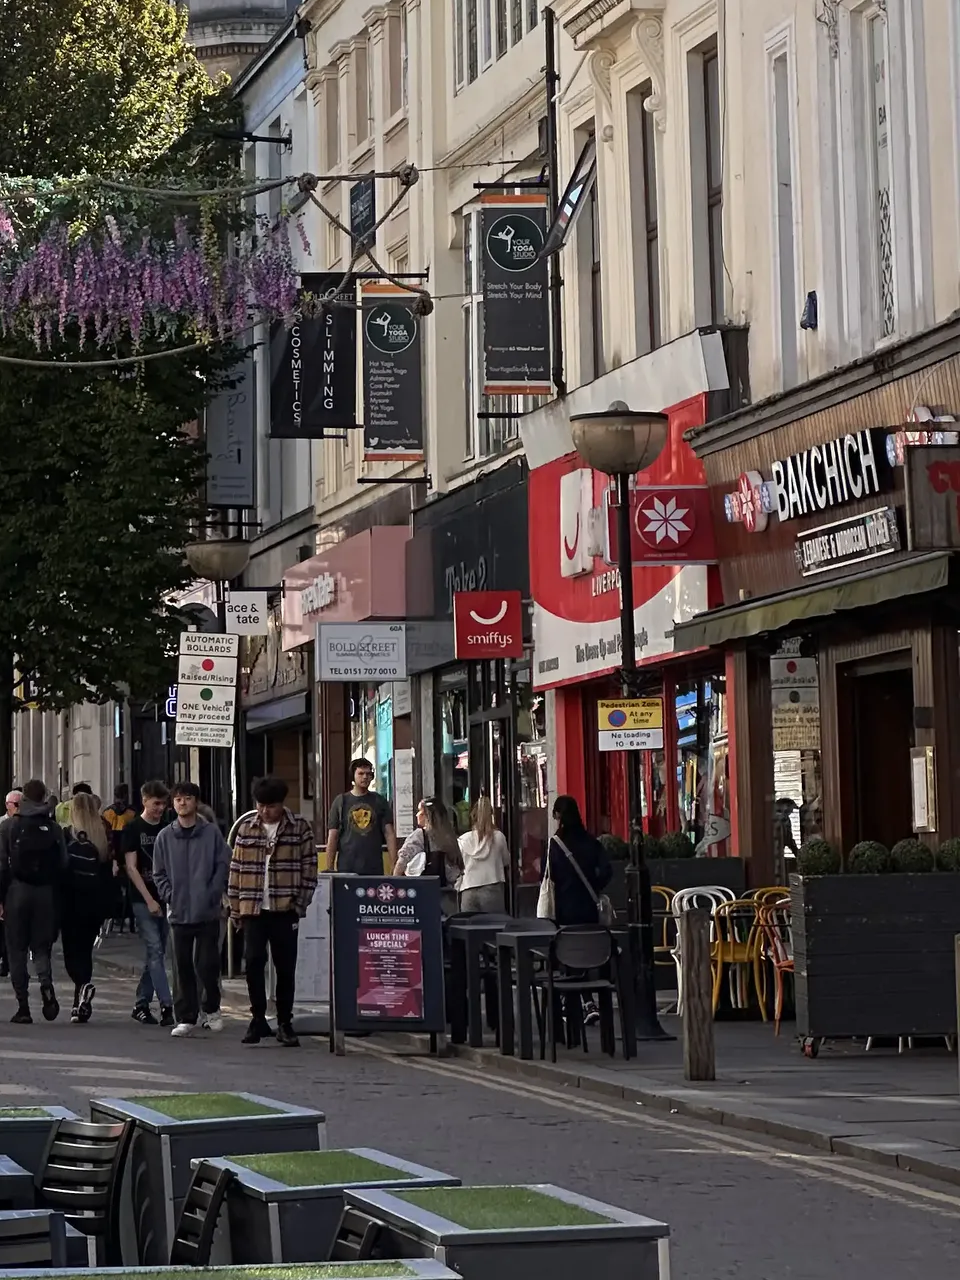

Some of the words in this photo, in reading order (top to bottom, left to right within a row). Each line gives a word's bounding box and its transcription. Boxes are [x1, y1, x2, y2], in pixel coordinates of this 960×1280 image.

[525, 283, 542, 291] Body
[525, 291, 542, 299] Mind
[323, 314, 334, 409] SLIMMING
[291, 326, 302, 422] COSMETICS
[393, 368, 407, 376] Yoga
[772, 428, 880, 522] BAKCHICH
[592, 568, 622, 597] LIVERPO
[227, 604, 248, 613] ace
[250, 603, 259, 612] &
[236, 614, 260, 624] tate
[185, 636, 234, 645] AUTOMATIC
[467, 632, 512, 648] smiffys
[187, 645, 231, 653] BOLLARDS
[329, 643, 356, 652] BOLD
[359, 642, 397, 652] STREET
[181, 673, 234, 683] Raised/Rising
[182, 703, 200, 711] ONE
[202, 704, 230, 712] Vehicle
[180, 712, 197, 720] may
[198, 713, 231, 721] proceed
[359, 904, 414, 915] BAKCHICH
[366, 933, 390, 941] LUNCH
[391, 933, 409, 941] TIME
[373, 940, 403, 948] SPECIAL
